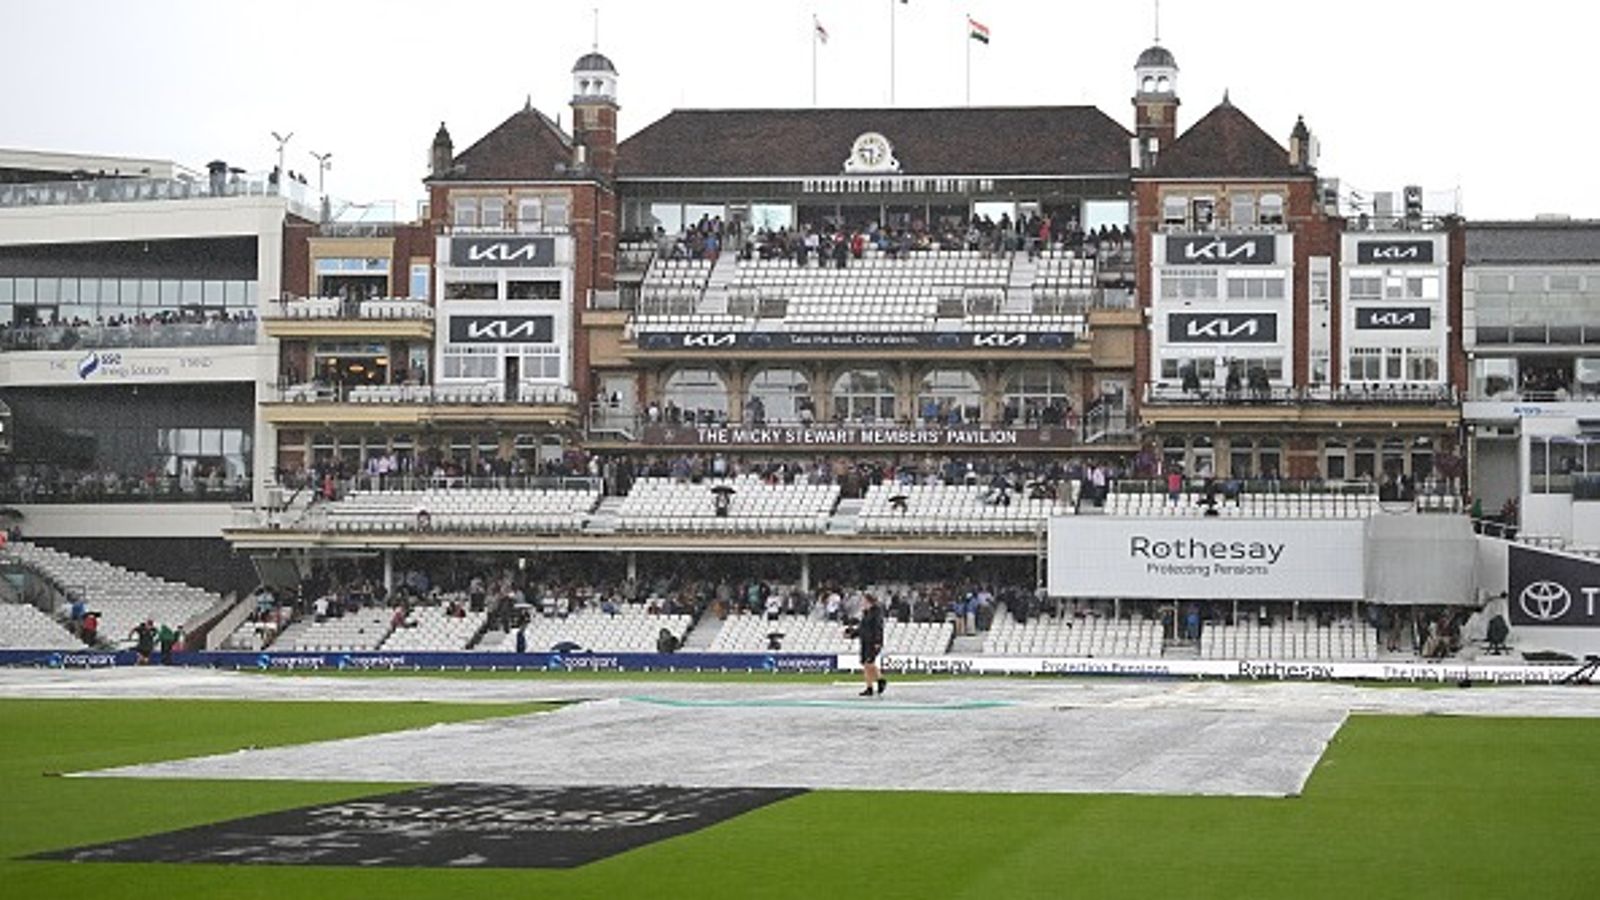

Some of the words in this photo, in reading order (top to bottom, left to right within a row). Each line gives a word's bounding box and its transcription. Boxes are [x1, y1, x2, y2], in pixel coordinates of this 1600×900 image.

[468, 242, 536, 260] KIA
[1185, 241, 1256, 258] KIA
[1373, 246, 1418, 258] KIA
[1187, 318, 1258, 336] KIA
[1370, 312, 1416, 325] KIA
[468, 320, 535, 338] KIA
[697, 428, 728, 444] THE
[732, 428, 782, 444] MICKY
[785, 428, 854, 444] STEWART
[861, 428, 943, 444] MEMBERS'
[946, 428, 1017, 444] PAVILION
[1130, 535, 1285, 565] Rothesay
[1147, 564, 1210, 577] Protecting
[1214, 564, 1268, 575] Pensions
